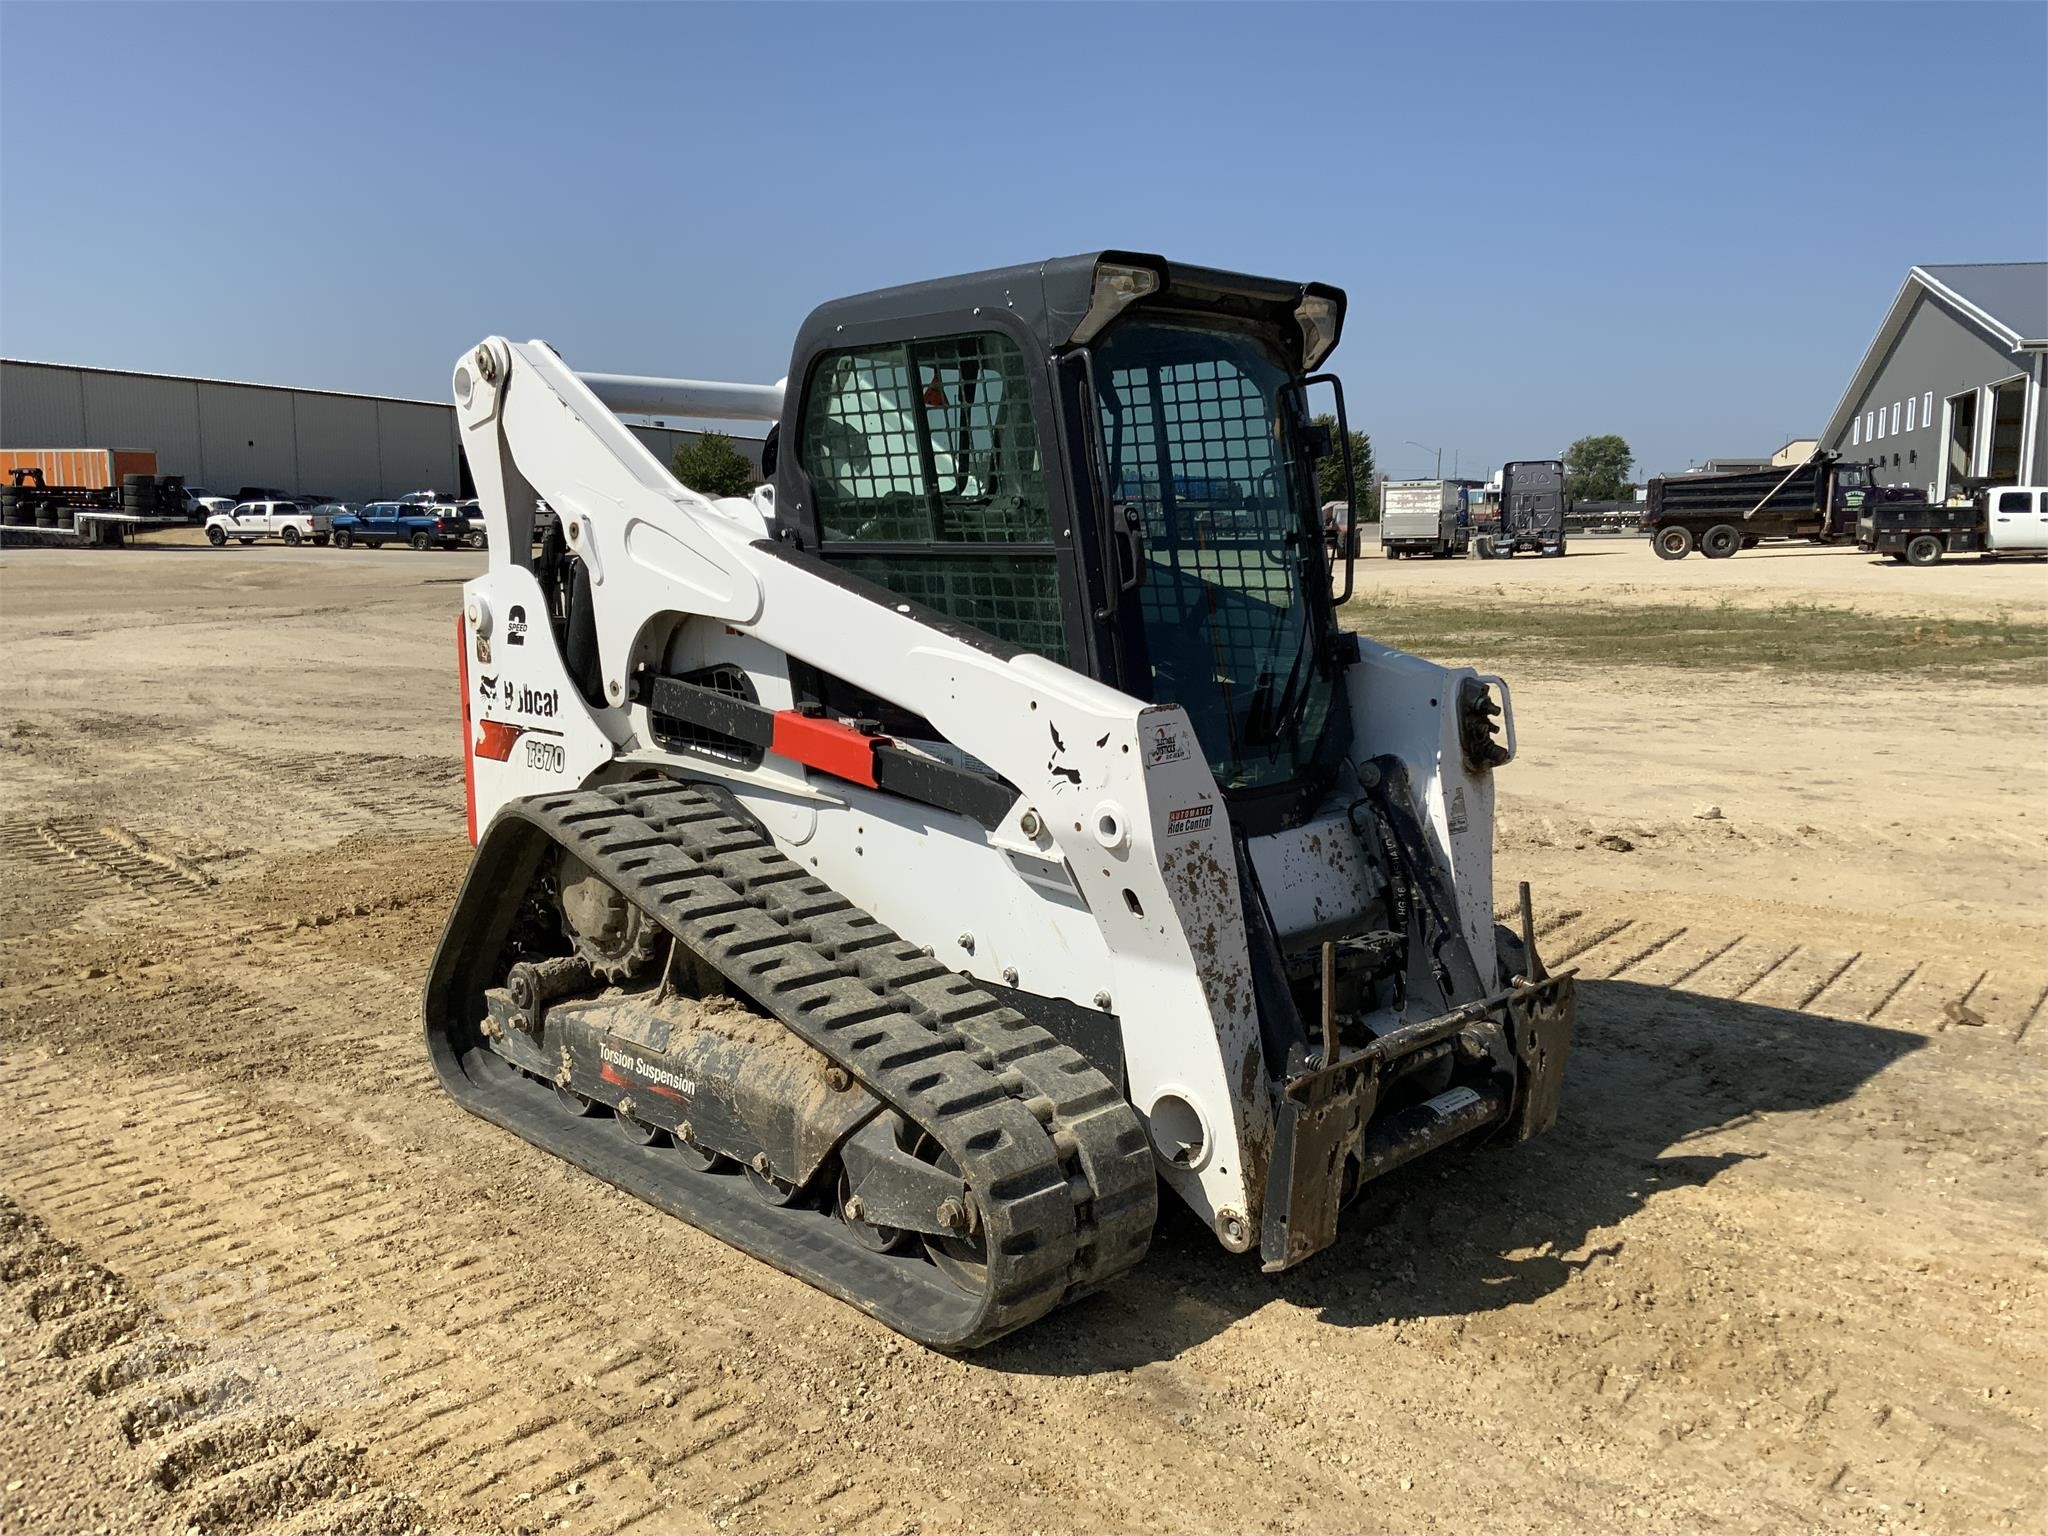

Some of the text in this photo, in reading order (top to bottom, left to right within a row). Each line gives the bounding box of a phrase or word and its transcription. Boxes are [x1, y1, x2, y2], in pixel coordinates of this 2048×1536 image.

[508, 622, 528, 633] SPEED
[526, 740, 565, 773] T870
[1170, 806, 1212, 820] AUTOMATIC
[1168, 815, 1212, 834] Ride Control
[599, 1042, 696, 1096] Torsion Suspension
